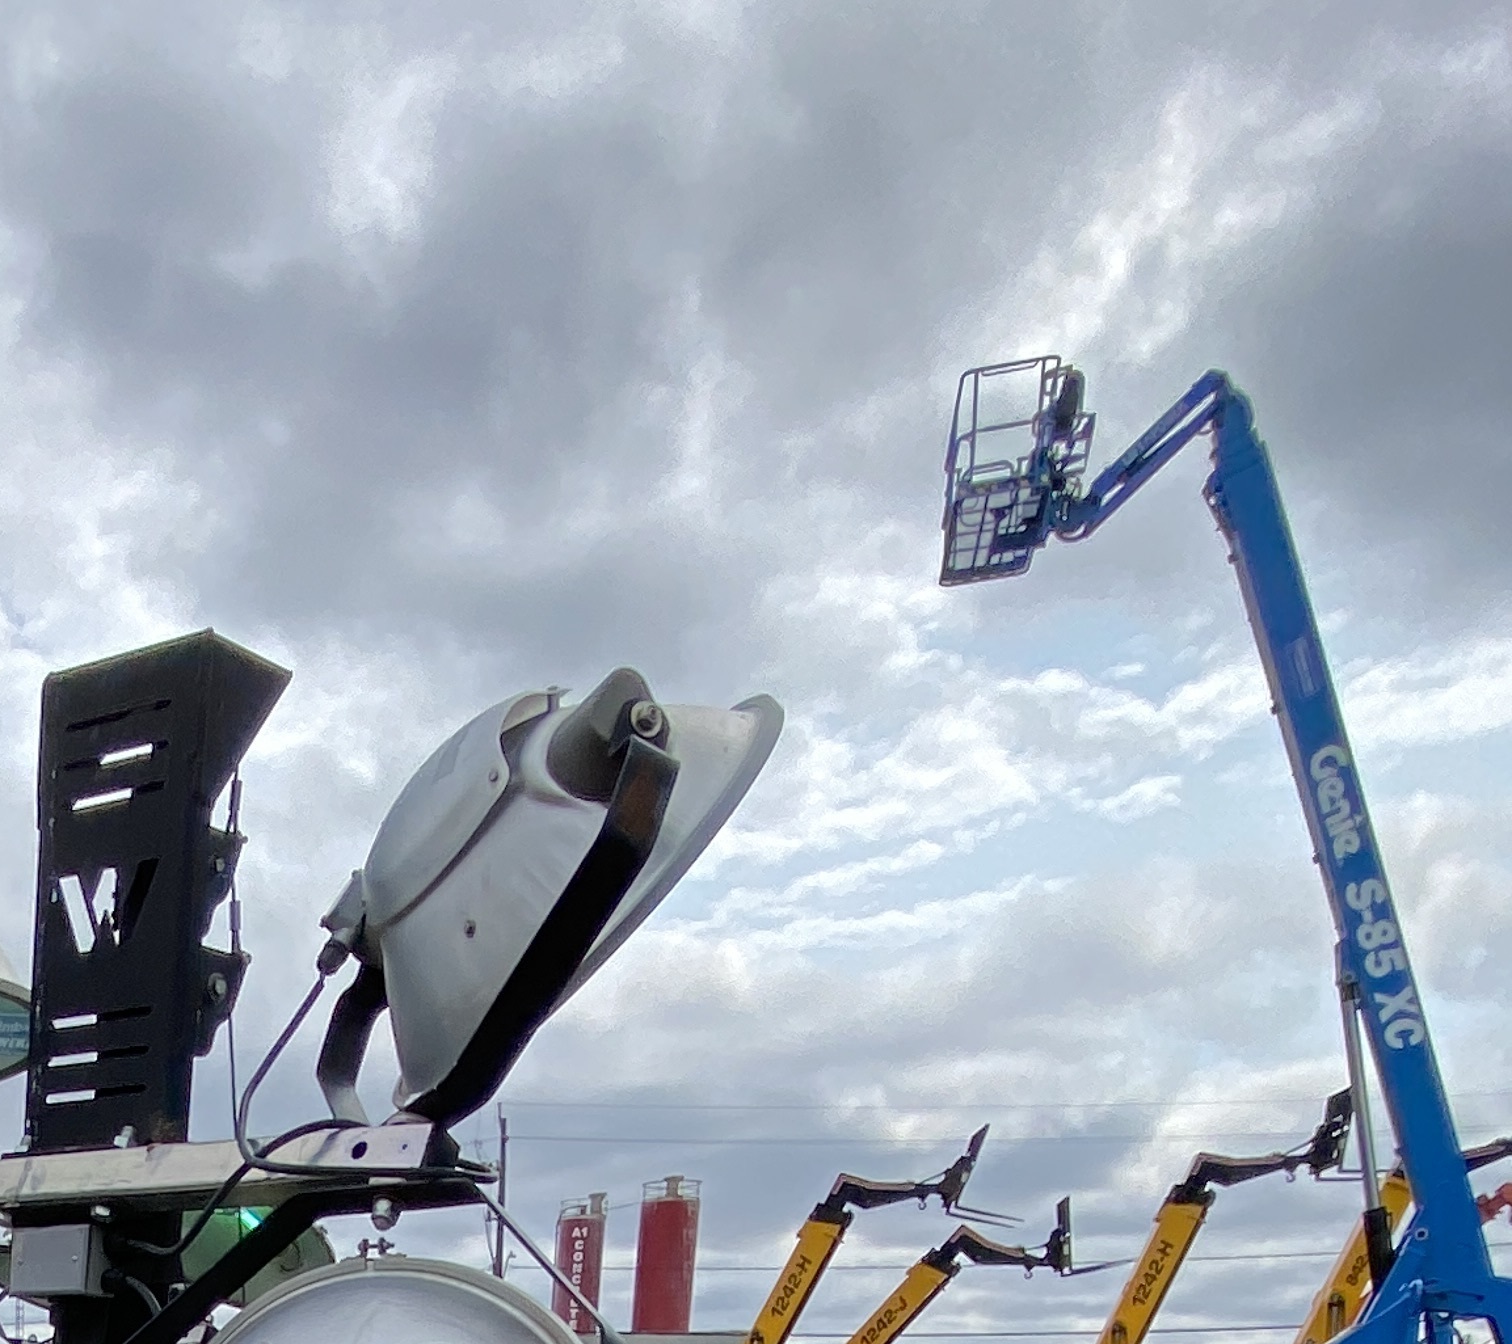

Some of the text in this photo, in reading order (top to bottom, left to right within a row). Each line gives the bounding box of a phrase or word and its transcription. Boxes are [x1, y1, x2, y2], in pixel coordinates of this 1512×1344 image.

[1309, 744, 1424, 1049] Genie S-85 XC
[568, 1226, 588, 1331] A1 CONCTE
[771, 1254, 812, 1318] 1242-H
[1132, 1240, 1174, 1307] 1242-H
